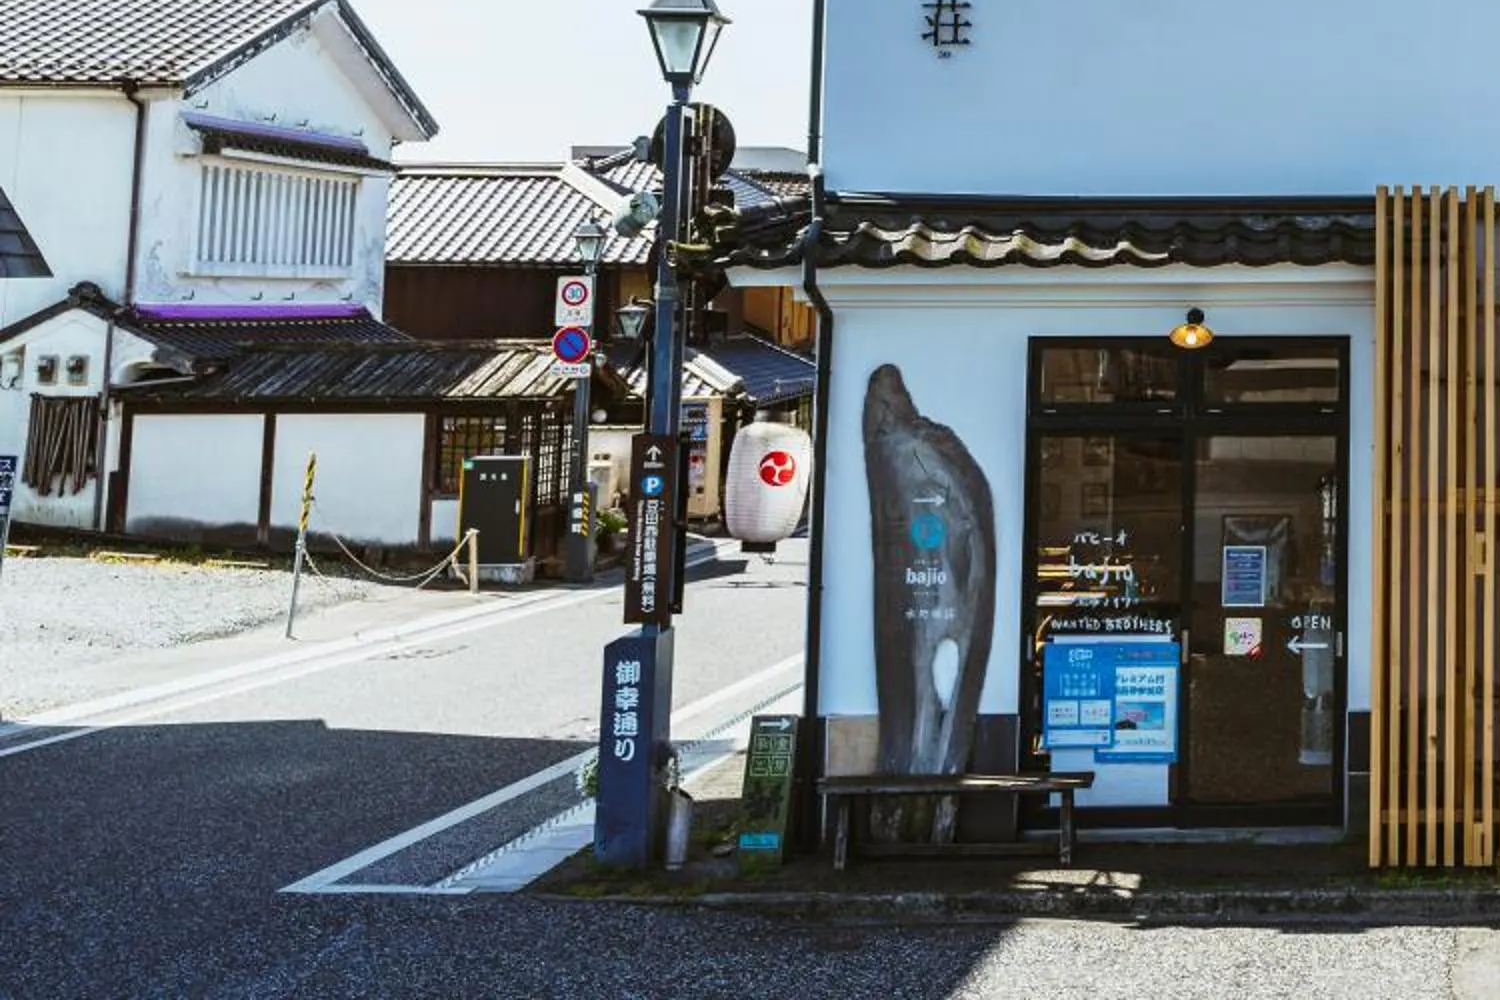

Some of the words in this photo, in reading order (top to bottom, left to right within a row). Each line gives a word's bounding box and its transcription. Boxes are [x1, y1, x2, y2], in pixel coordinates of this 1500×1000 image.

[567, 286, 583, 300] 30
[905, 567, 947, 587] bajio
[1105, 616, 1173, 634] BROTHERS
[1291, 615, 1331, 630] OPEN
[613, 660, 641, 761] 御幸通り
